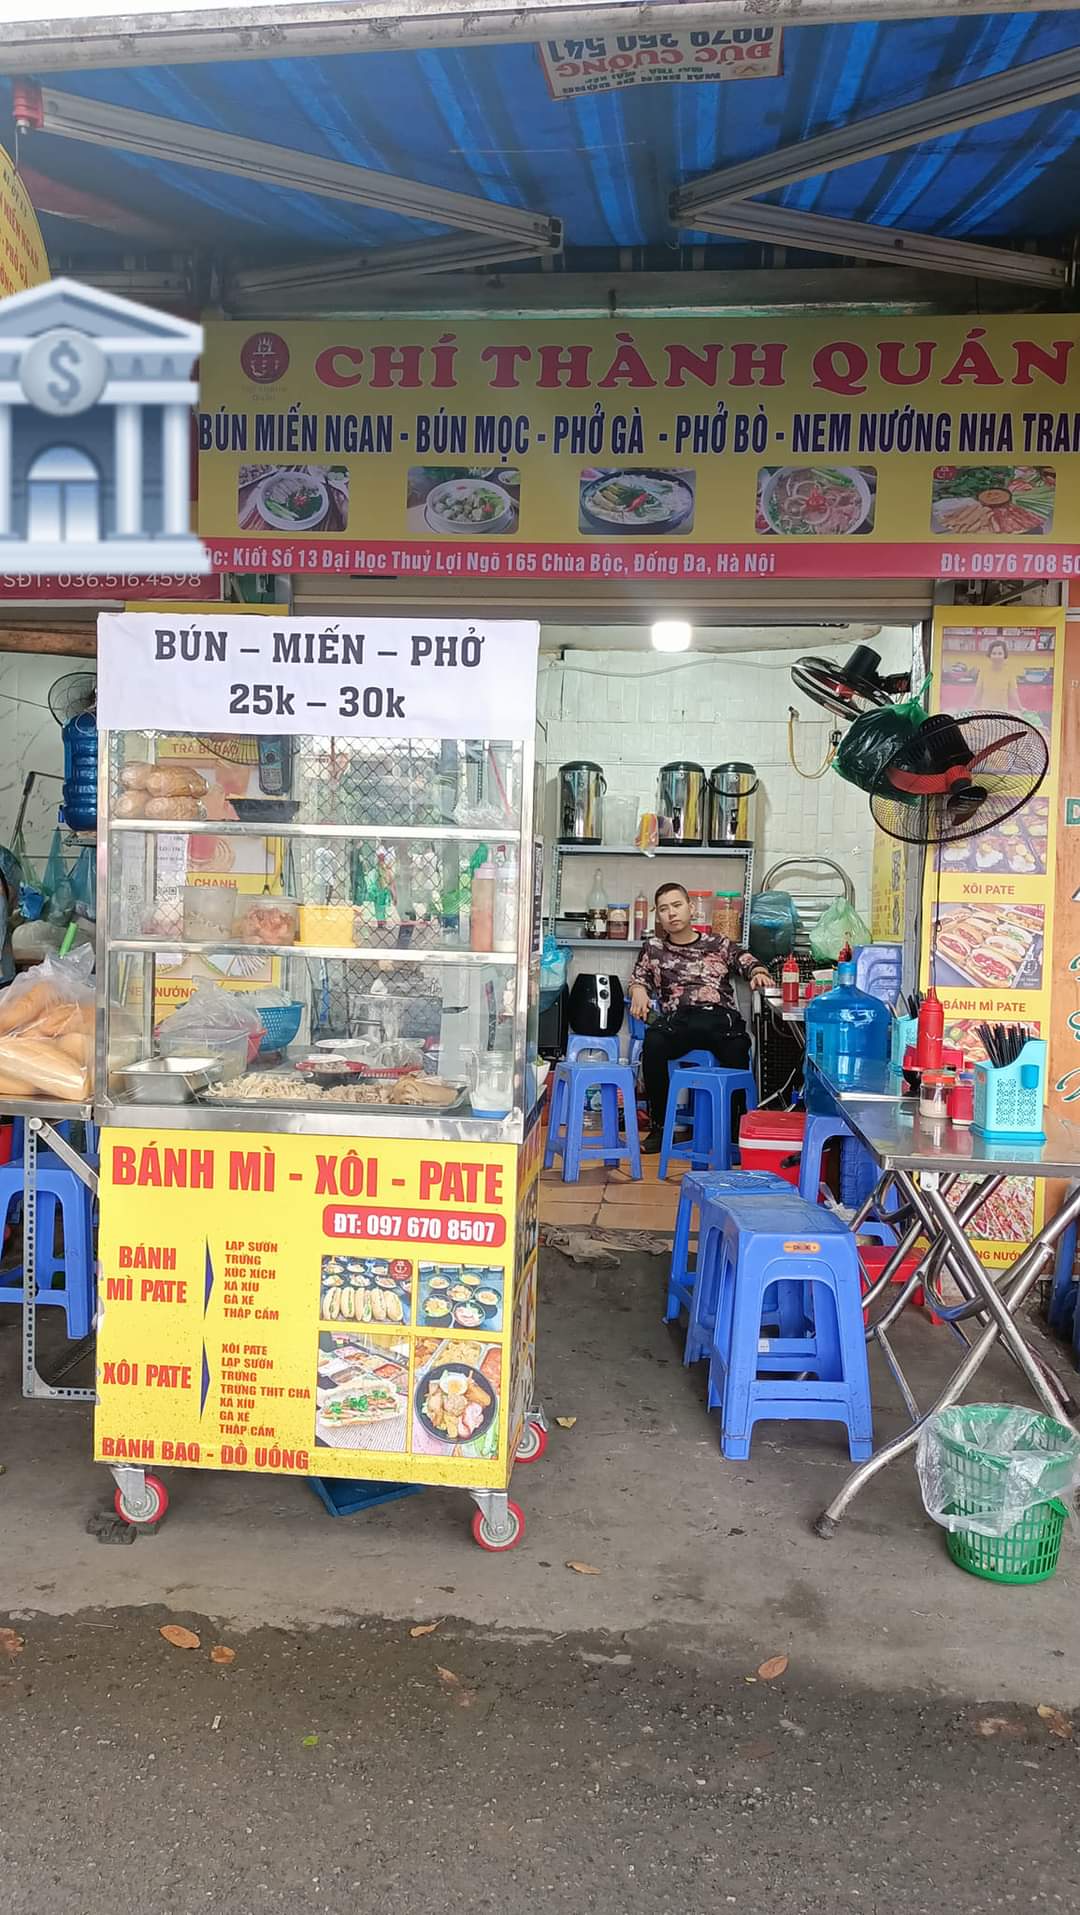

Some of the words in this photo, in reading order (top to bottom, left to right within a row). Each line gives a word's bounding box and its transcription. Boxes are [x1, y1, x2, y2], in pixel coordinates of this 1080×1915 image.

[694, 42, 774, 65] ĐỨC
[315, 333, 458, 388] CHÍ
[481, 332, 788, 388] THÀNH
[812, 328, 1075, 396] QUÁN
[200, 406, 247, 451] BÚN
[255, 402, 318, 452] MIẾN
[325, 414, 393, 452] NGAN
[416, 407, 467, 453] BÚN
[474, 415, 529, 463] MỌC
[553, 402, 605, 454] PHỞ
[611, 406, 644, 454] GÀ
[675, 401, 728, 453] PHỞ
[734, 404, 768, 453] BÒ
[792, 413, 851, 452] NEM
[858, 404, 951, 453] NƯỚNG
[959, 413, 1015, 452] NHA
[205, 546, 228, 567] c:
[233, 545, 267, 567] Kiốt
[272, 545, 295, 568] Số
[298, 549, 318, 568] 13
[322, 549, 349, 572] Đại
[354, 550, 386, 572] Học
[435, 550, 461, 573] Lợi
[467, 550, 500, 573] Ngõ
[505, 552, 537, 571] 165
[542, 552, 585, 572] Chùa
[590, 552, 629, 576] Bộc,
[633, 549, 678, 575] Đống
[683, 553, 712, 575] Đa,
[717, 552, 739, 572] Hà
[744, 553, 775, 576] Nội
[941, 553, 966, 572] Đt:
[972, 553, 1017, 573] 0976
[1023, 553, 1057, 573] 708
[154, 624, 228, 662] BÚN
[272, 624, 365, 664] MIẾN
[410, 627, 485, 667] PHỞ
[229, 683, 295, 715] 25k
[338, 686, 406, 718] 30k
[962, 882, 982, 894] XÔI
[985, 884, 1015, 895] PATE
[944, 999, 976, 1010] BÁNH
[979, 999, 994, 1011] MÌ
[996, 1001, 1026, 1013] PATE
[112, 1141, 214, 1189] BÁNH
[229, 1146, 275, 1192] MÌ
[314, 1149, 378, 1197] XÔI
[419, 1160, 503, 1205] PATE
[334, 1213, 361, 1234] ĐT:
[366, 1214, 402, 1236] 097
[407, 1217, 442, 1239] 670
[447, 1219, 496, 1242] 8507
[119, 1243, 177, 1270] BÁNH
[993, 1249, 1021, 1260] NƯỚ
[107, 1275, 134, 1301] MÌ
[141, 1279, 187, 1303] PATE
[222, 1342, 240, 1354] XÔI
[244, 1345, 268, 1356] PATE
[103, 1358, 138, 1385] XÔI
[145, 1364, 192, 1389] PATE
[102, 1435, 154, 1459] BÁNH
[221, 1439, 247, 1465] ĐỒ
[254, 1441, 309, 1470] UỐNG
